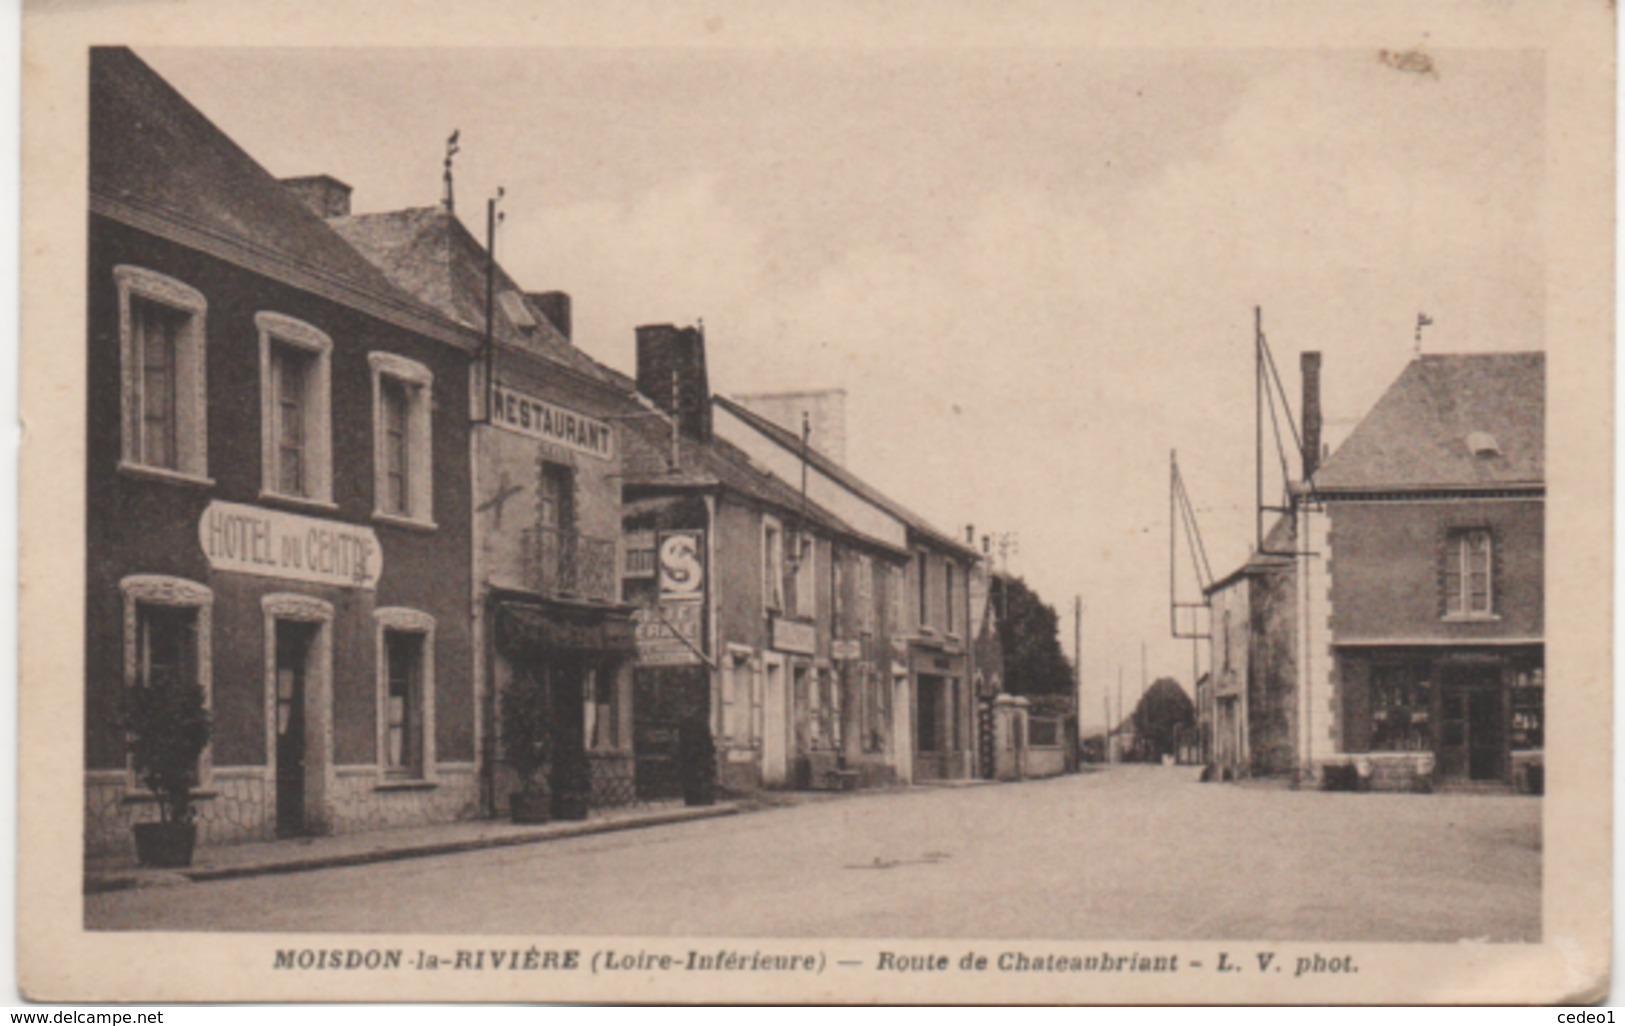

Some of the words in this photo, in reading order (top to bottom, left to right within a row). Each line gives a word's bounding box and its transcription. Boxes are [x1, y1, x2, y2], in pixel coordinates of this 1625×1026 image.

[492, 389, 611, 454] RESTAURANT
[208, 509, 277, 565] HOTEL
[281, 534, 302, 568] DU
[305, 527, 375, 583] CENTRE
